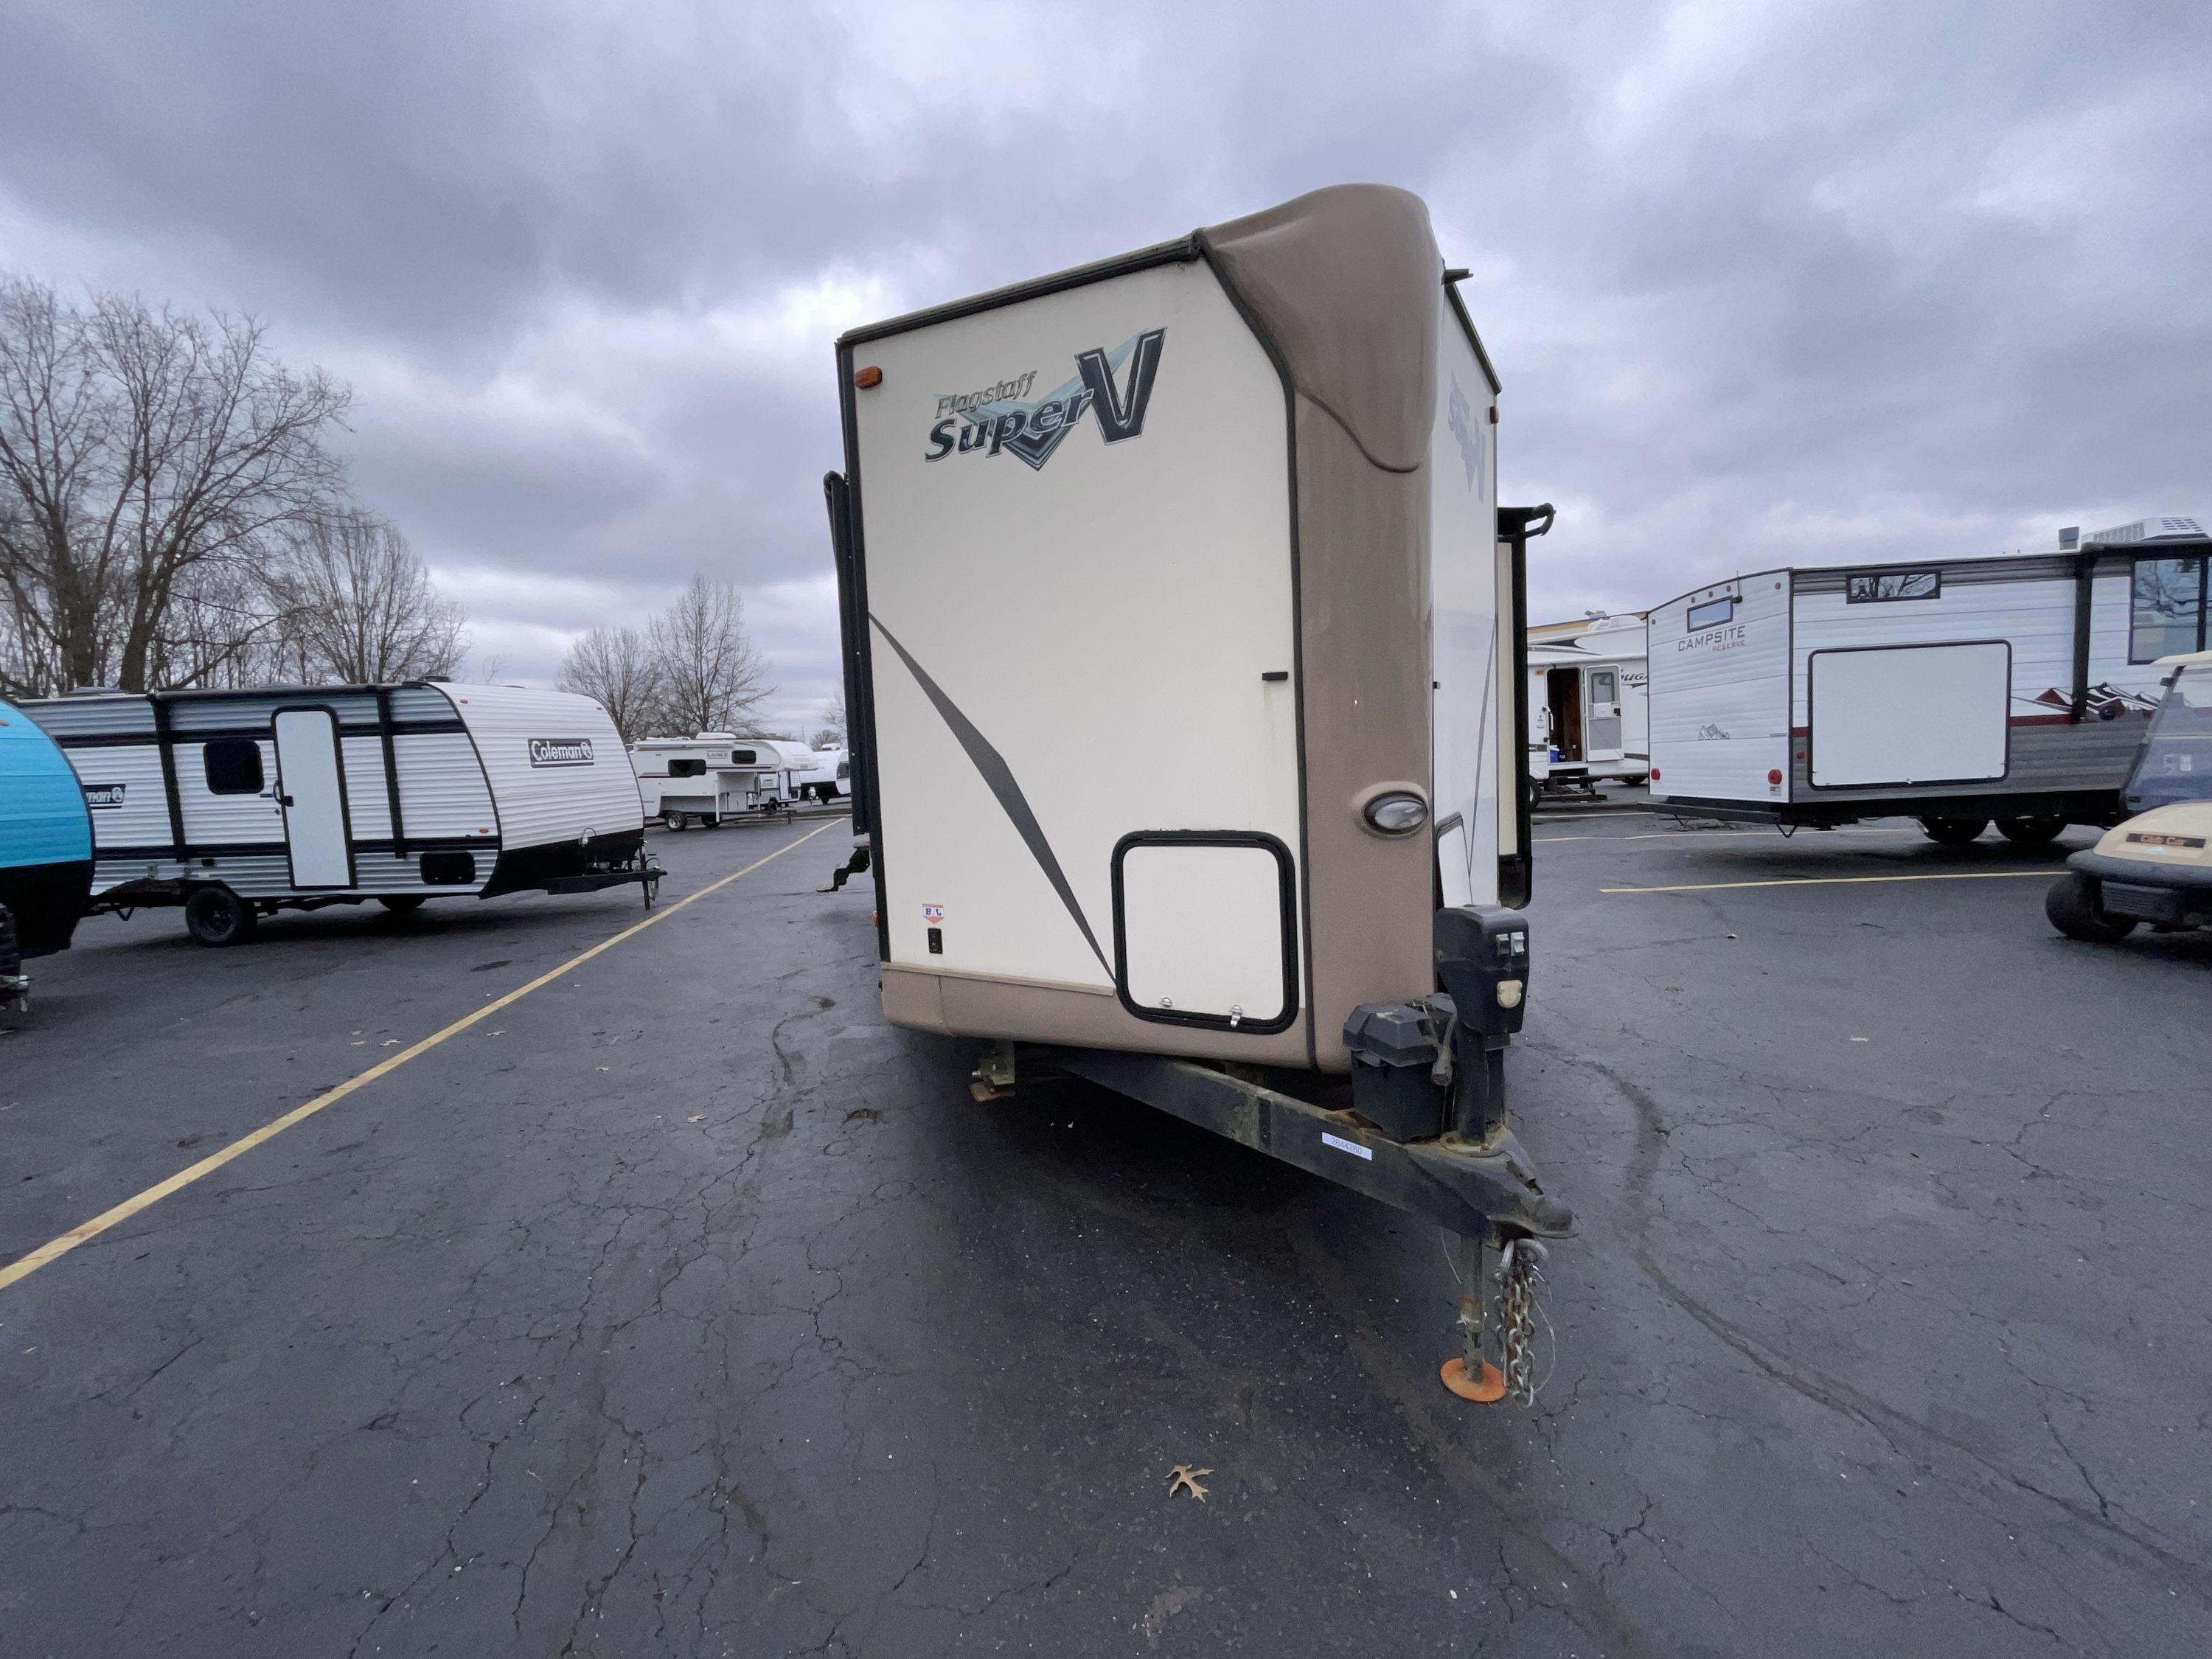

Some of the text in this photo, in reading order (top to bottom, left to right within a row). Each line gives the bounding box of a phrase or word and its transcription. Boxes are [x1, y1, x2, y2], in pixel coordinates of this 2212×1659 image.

[925, 325, 1168, 463] Super V
[935, 370, 1038, 420] Flagstaff
[1678, 625, 1745, 652] CAMPSITE
[1712, 639, 1746, 652] RESERVE
[531, 740, 582, 761] Coleman
[1331, 1137, 1363, 1155] 2644260
